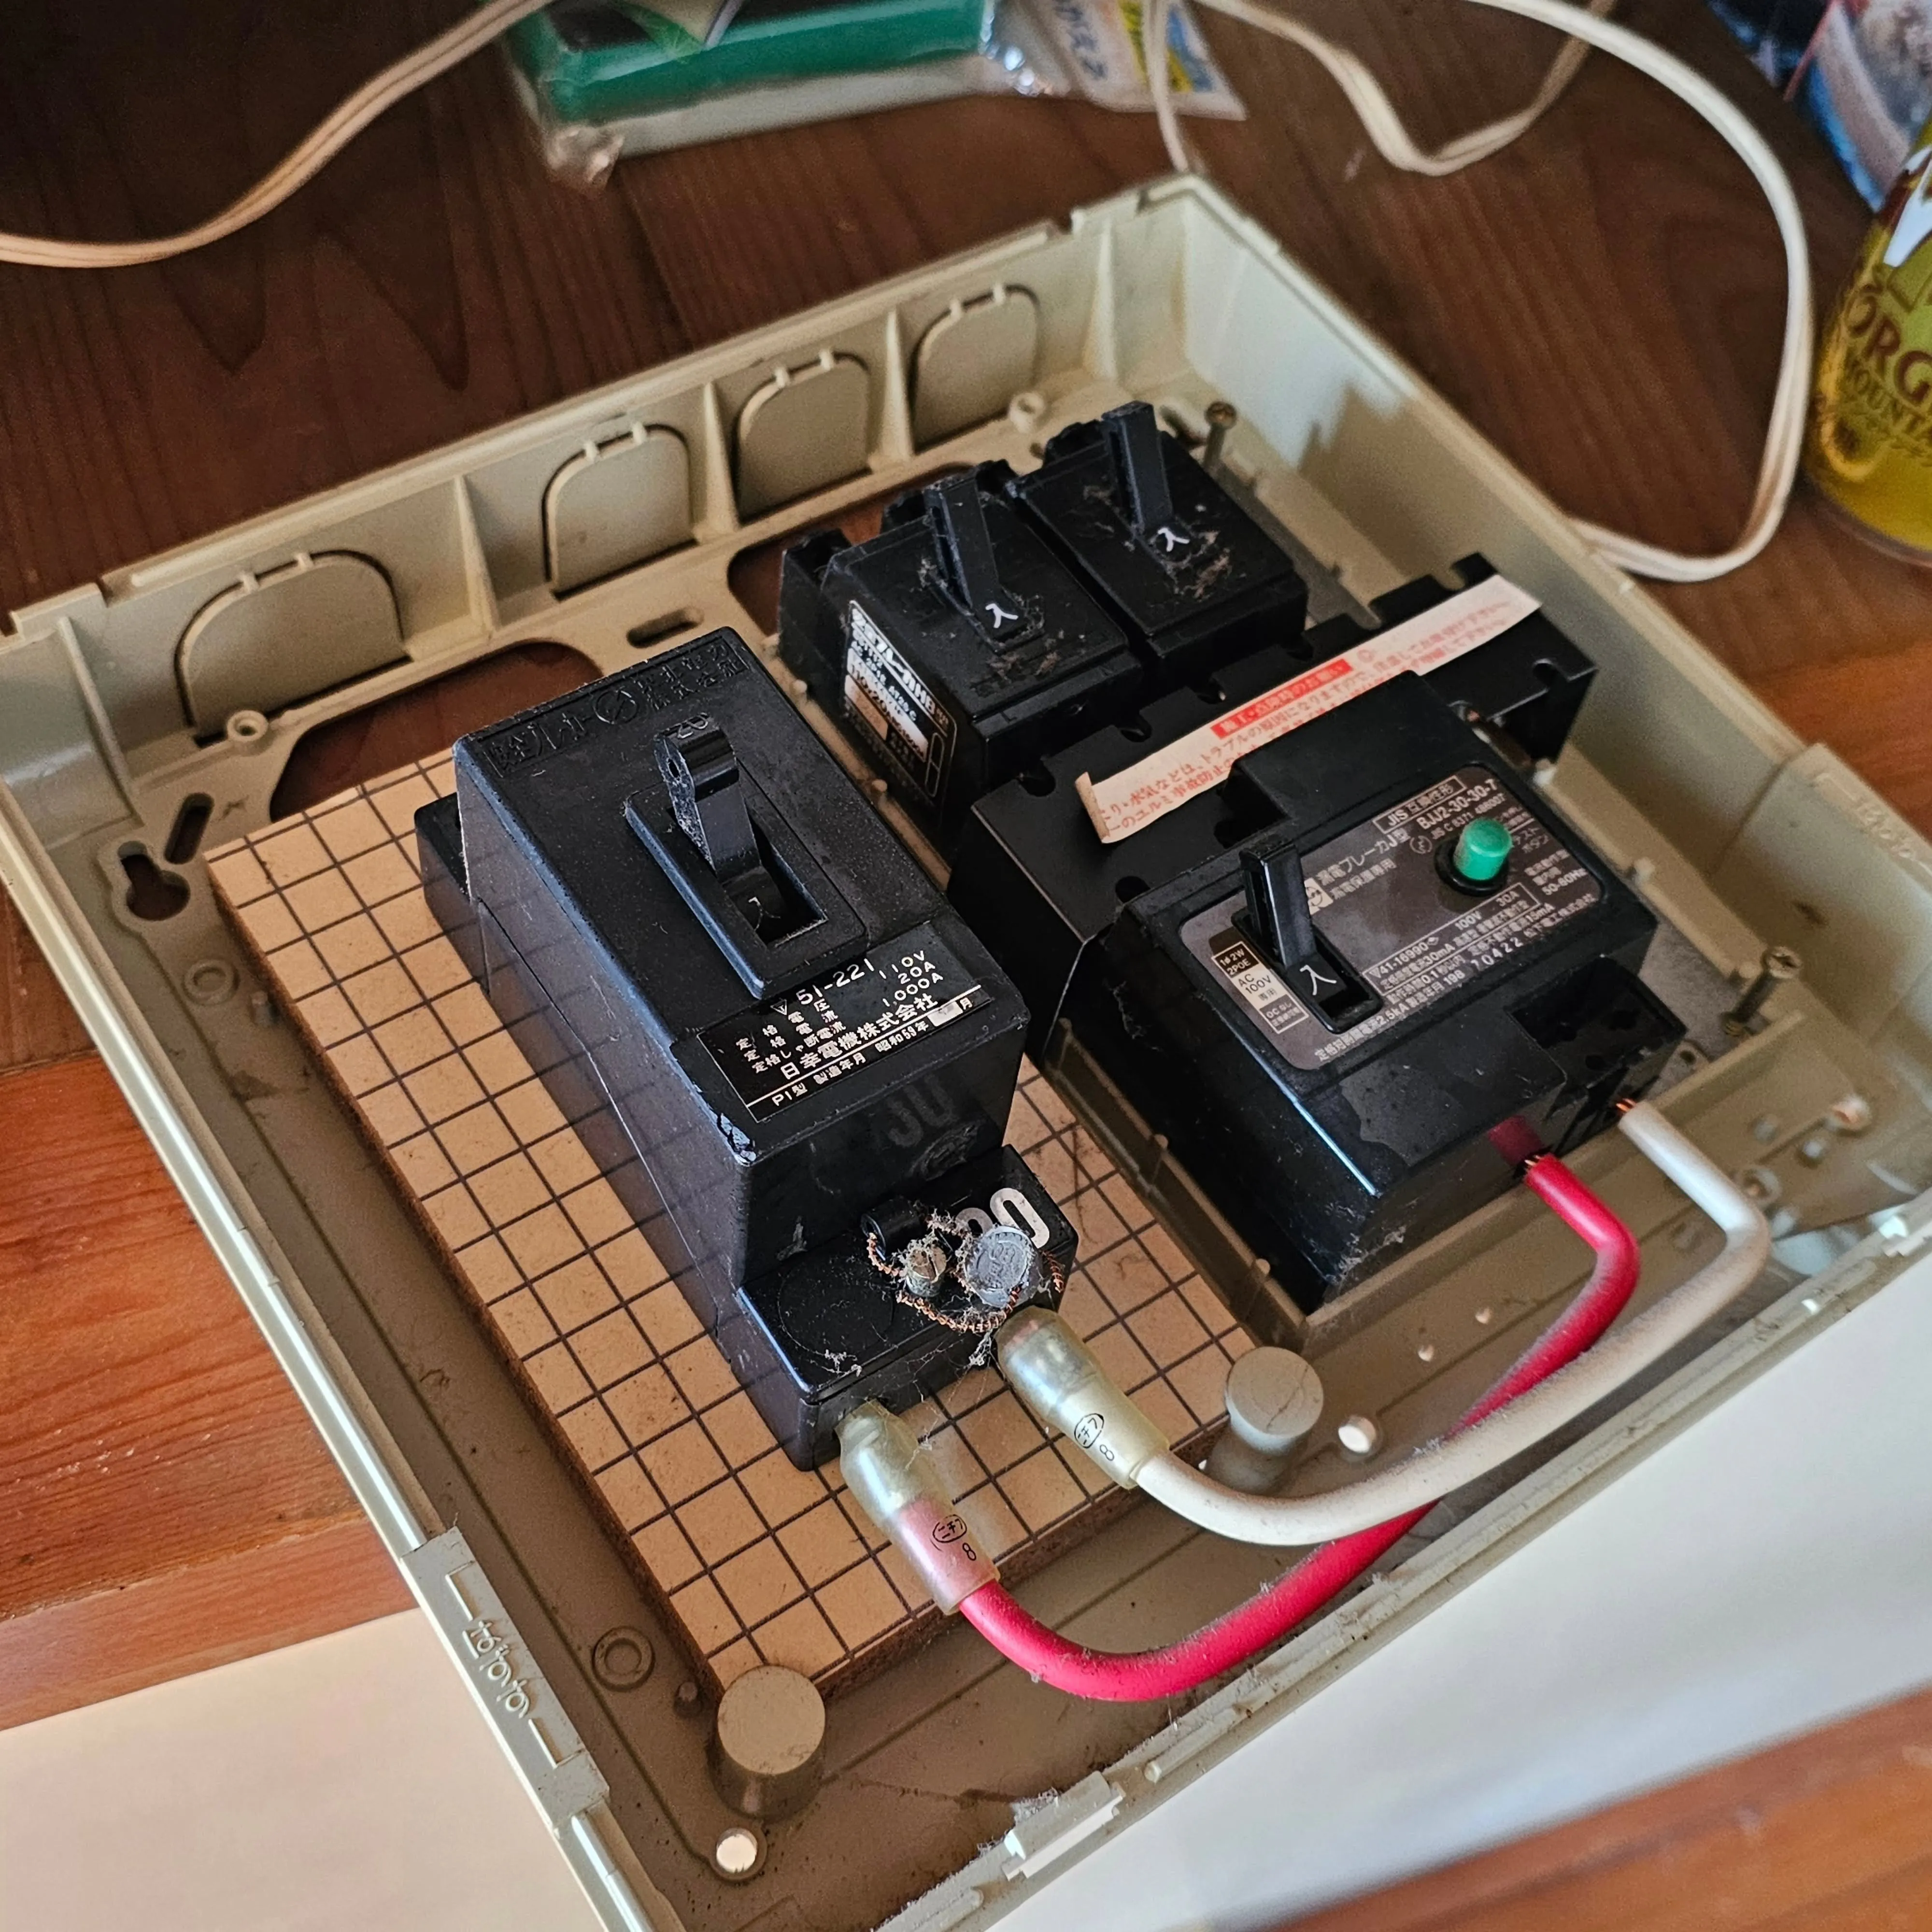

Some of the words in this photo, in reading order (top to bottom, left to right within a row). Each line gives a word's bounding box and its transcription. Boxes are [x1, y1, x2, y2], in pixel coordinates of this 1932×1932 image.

[1157, 526, 1190, 552] 入
[985, 602, 1019, 628] 入
[1414, 777, 1503, 831] BJJ2-30-30-7
[1453, 909, 1485, 932] 100V
[1494, 888, 1521, 908] 30A
[876, 949, 930, 980] 110V
[895, 959, 938, 985] 20A
[793, 957, 877, 1006] 51-221
[881, 970, 946, 1009] 1,000A
[1236, 972, 1256, 988] AC
[1243, 974, 1274, 995] 100V
[1299, 965, 1336, 995] 入
[777, 990, 940, 1081] 日幸電機株式会社
[1099, 1444, 1115, 1462] 8
[962, 1542, 977, 1561] 8
